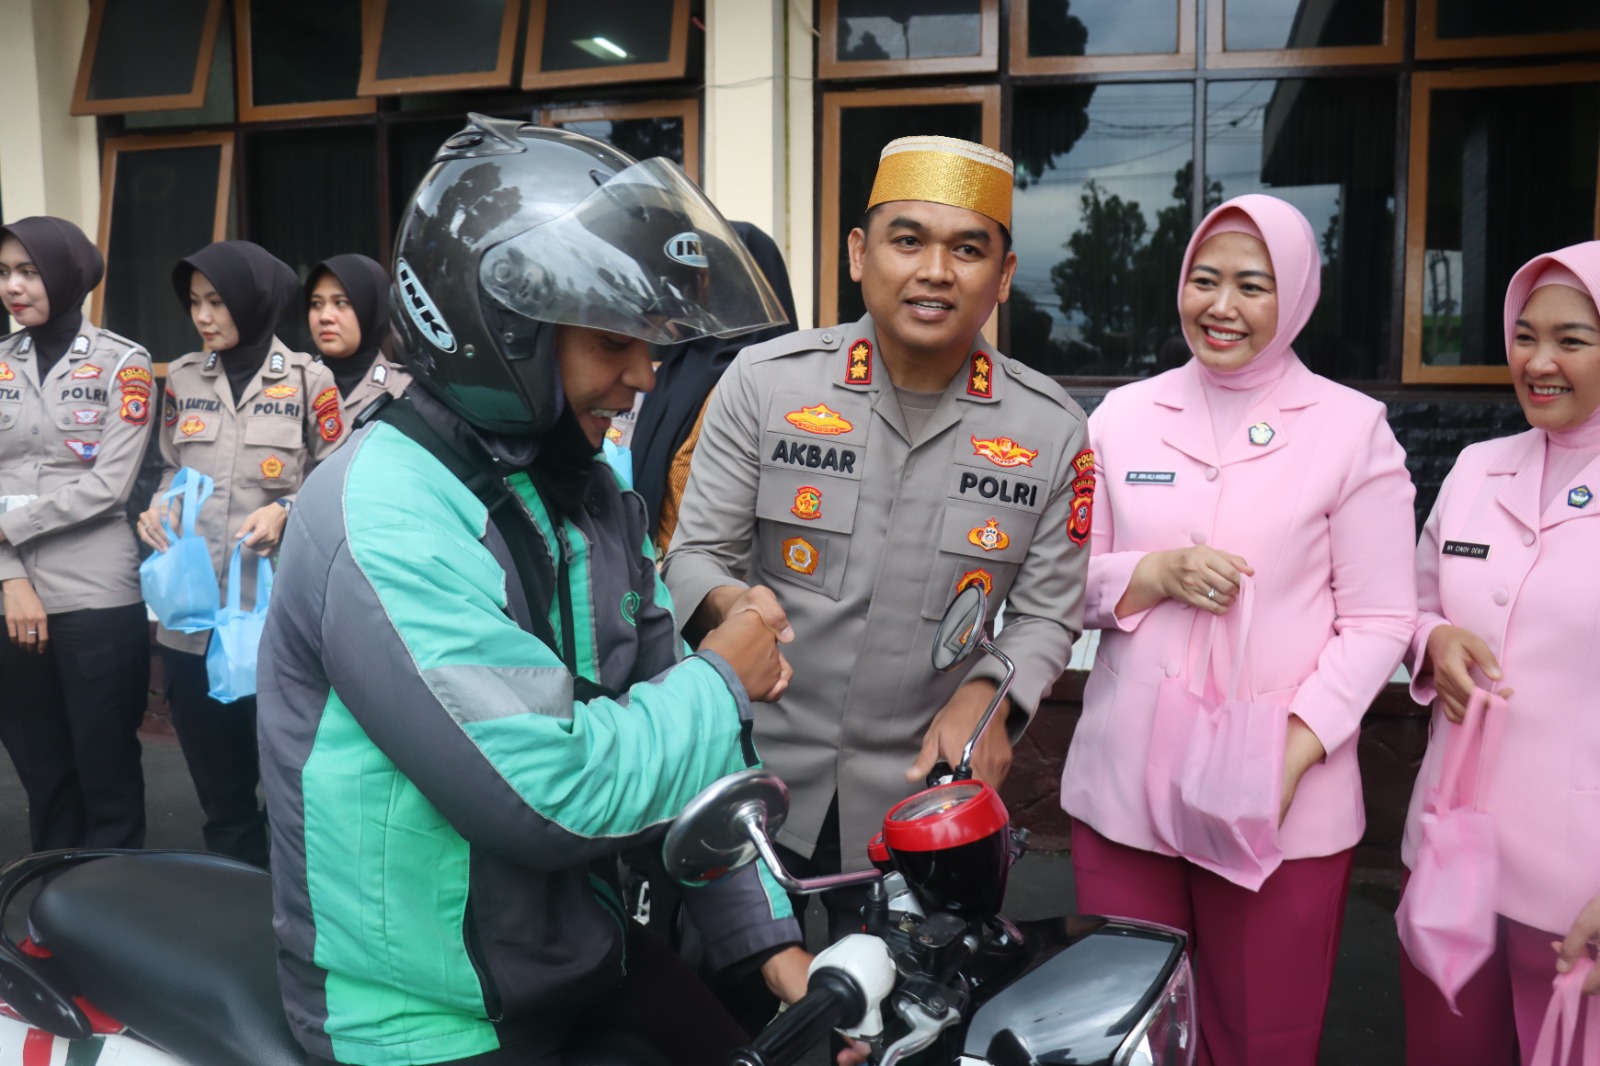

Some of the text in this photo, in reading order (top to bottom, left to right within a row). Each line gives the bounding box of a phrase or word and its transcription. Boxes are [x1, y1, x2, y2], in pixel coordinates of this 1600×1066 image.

[400, 268, 450, 340] INK
[61, 387, 108, 402] POLRI
[253, 402, 300, 417] POLRI
[771, 439, 857, 474] AKBAR
[959, 471, 1038, 507] POLRI
